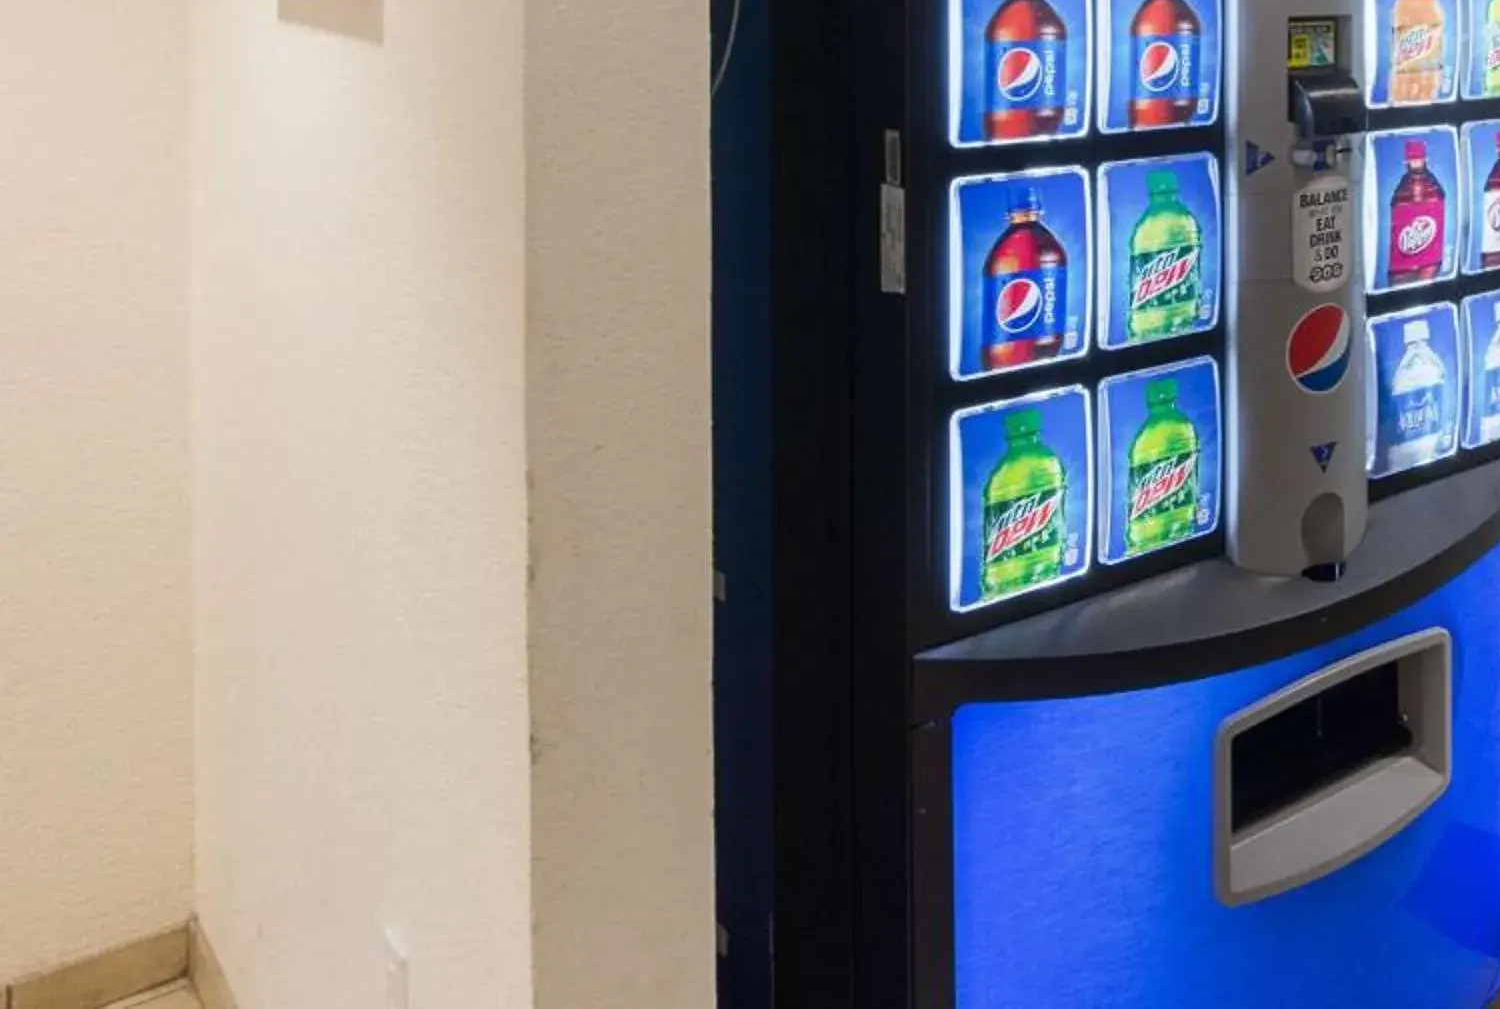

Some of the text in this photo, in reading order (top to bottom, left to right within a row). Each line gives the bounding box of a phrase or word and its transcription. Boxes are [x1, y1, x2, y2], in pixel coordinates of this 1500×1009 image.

[1316, 216, 1336, 232] EAT
[1309, 230, 1342, 248] DRINK
[1325, 247, 1338, 260] DO
